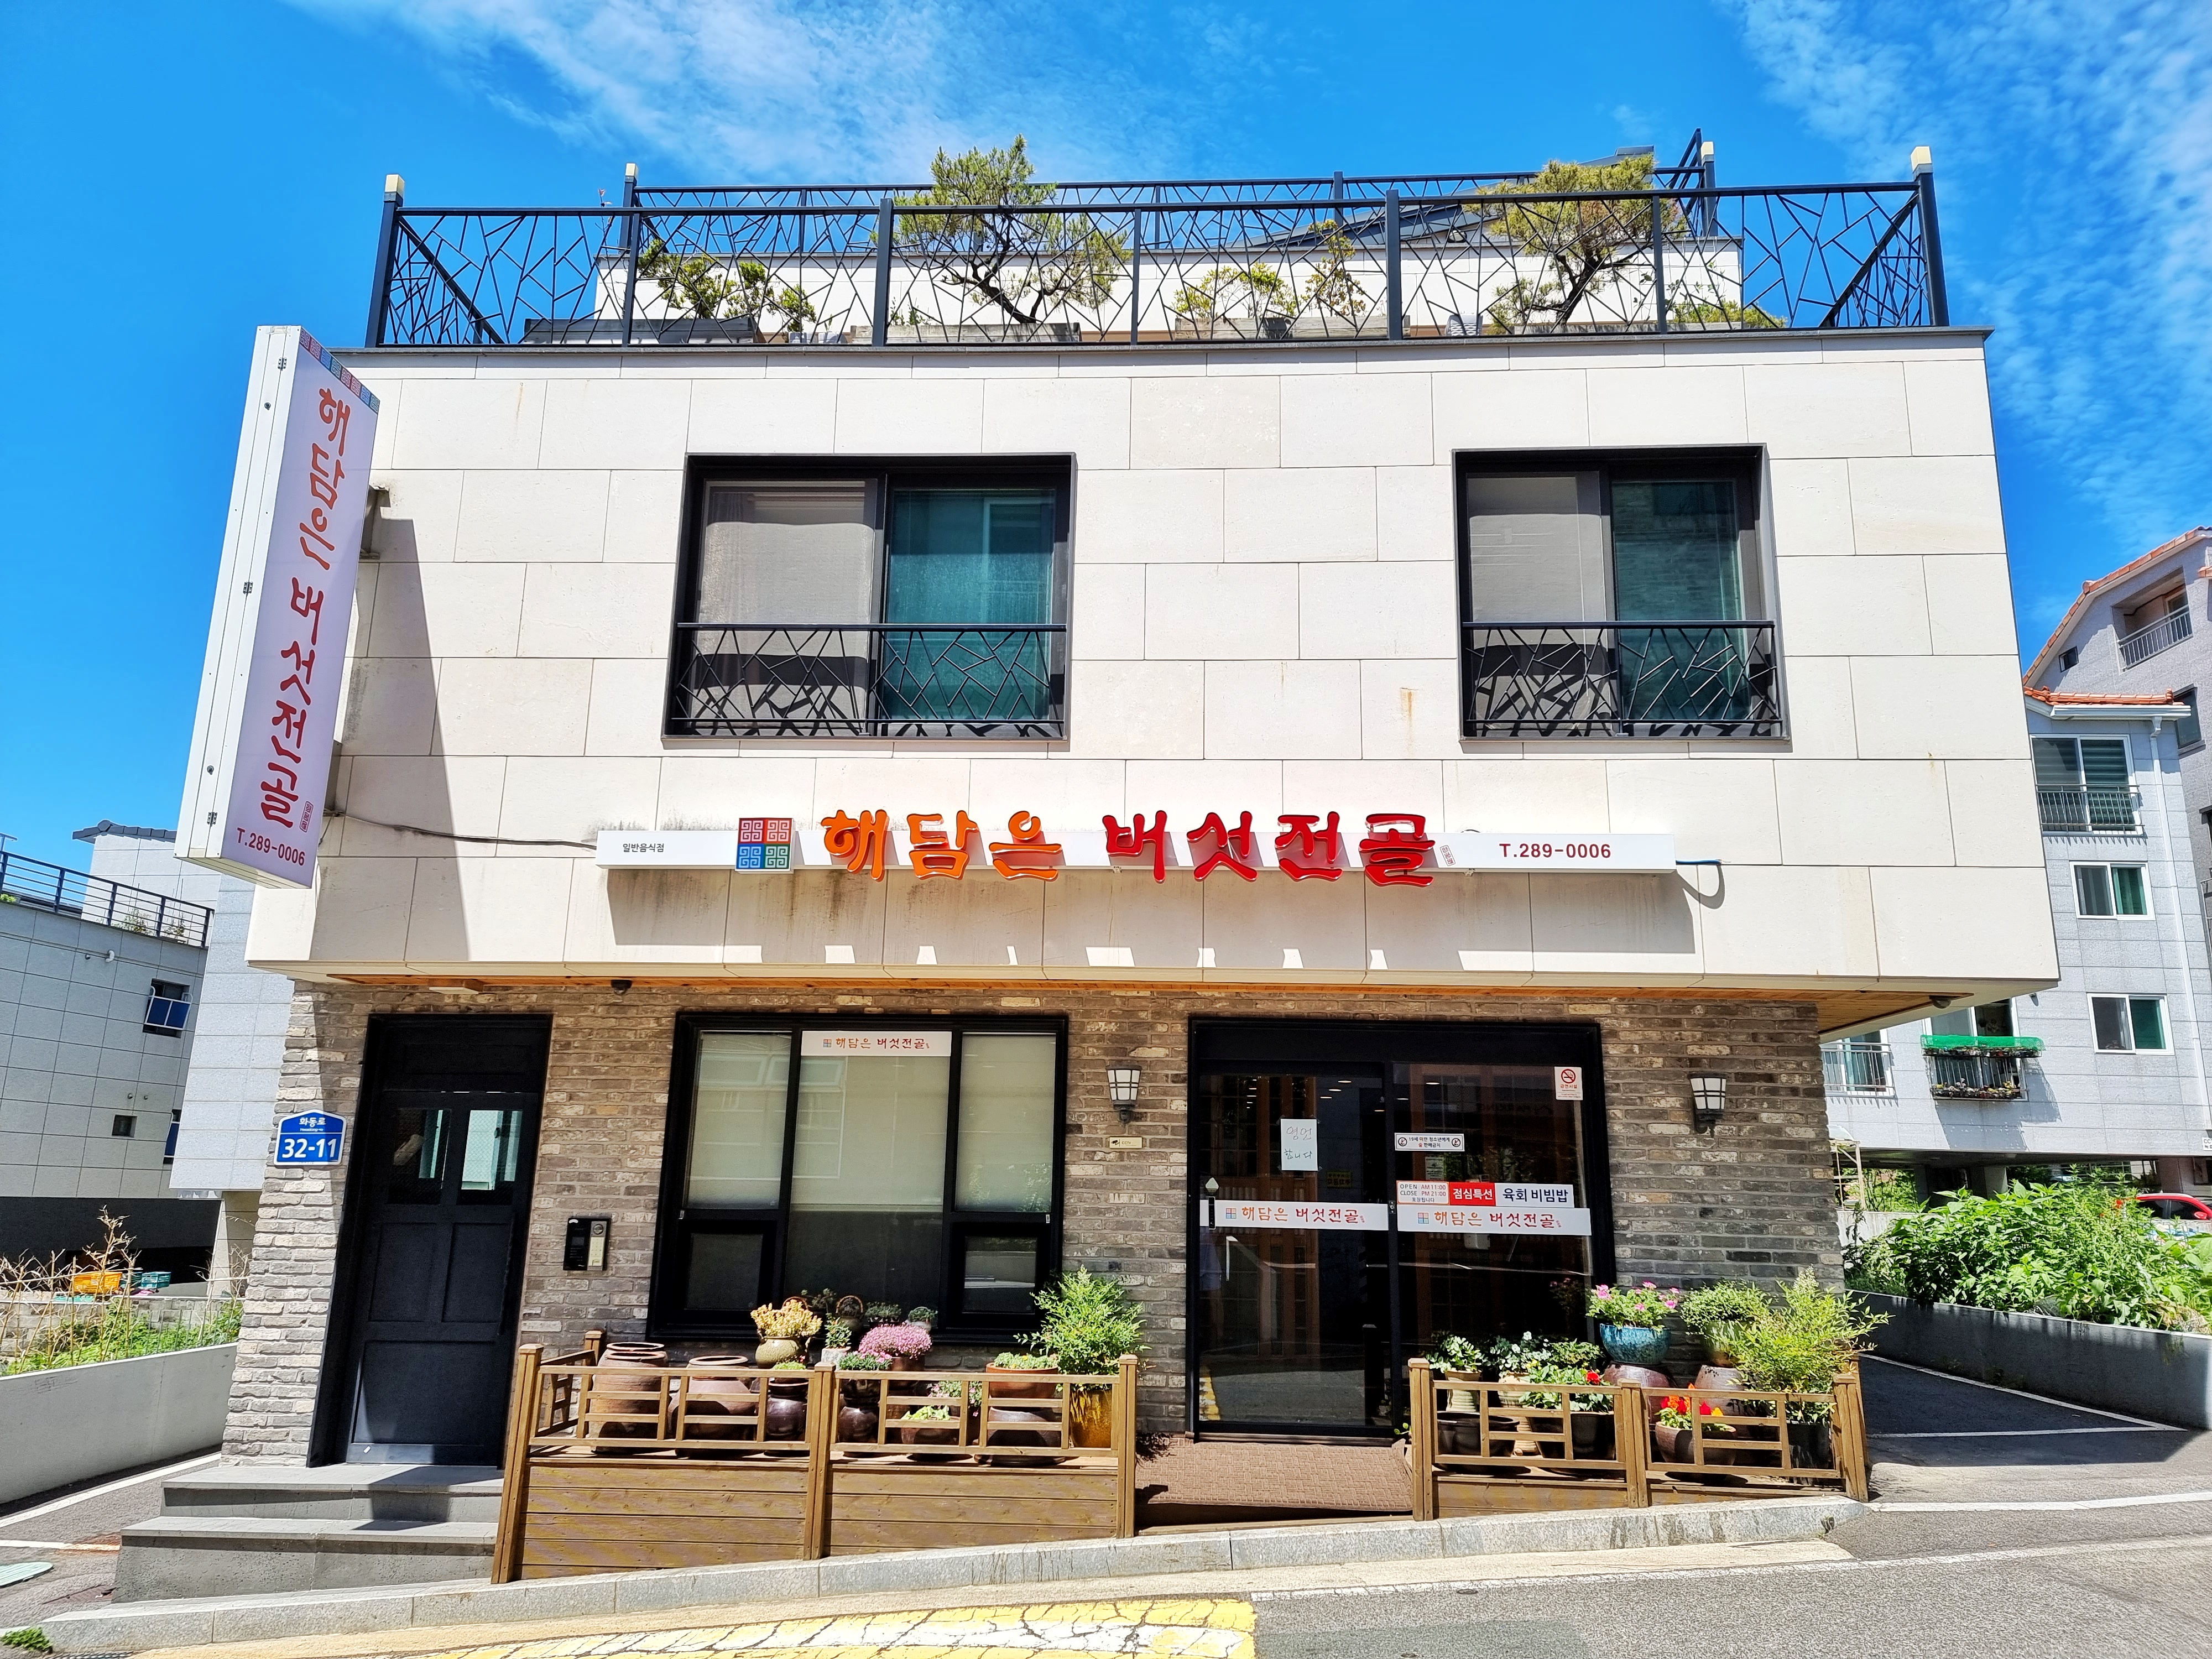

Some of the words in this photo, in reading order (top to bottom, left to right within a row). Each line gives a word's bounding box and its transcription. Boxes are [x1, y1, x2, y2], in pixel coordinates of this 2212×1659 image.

[299, 387, 351, 571] 해담은
[260, 577, 324, 828] 버섯전골
[237, 827, 305, 866] T.289-0006
[623, 843, 664, 853] 일반음식점
[821, 809, 1062, 882] 해담은
[1102, 810, 1436, 887] 버섯전골
[1499, 843, 1611, 859] T.289-0006
[836, 1037, 872, 1049] 해담은
[877, 1038, 925, 1050] 버섯전골
[299, 1117, 326, 1128] 화동로
[282, 1138, 337, 1158] 32-11
[1453, 1188, 1493, 1200] 점심특선
[1503, 1188, 1527, 1202] 육회
[1531, 1189, 1569, 1203] 비빔밥
[1241, 1207, 1288, 1222] 해담은
[1295, 1208, 1359, 1224] 버섯전골
[1434, 1211, 1483, 1226] 해담은
[1489, 1212, 1555, 1228] 버섯전골
